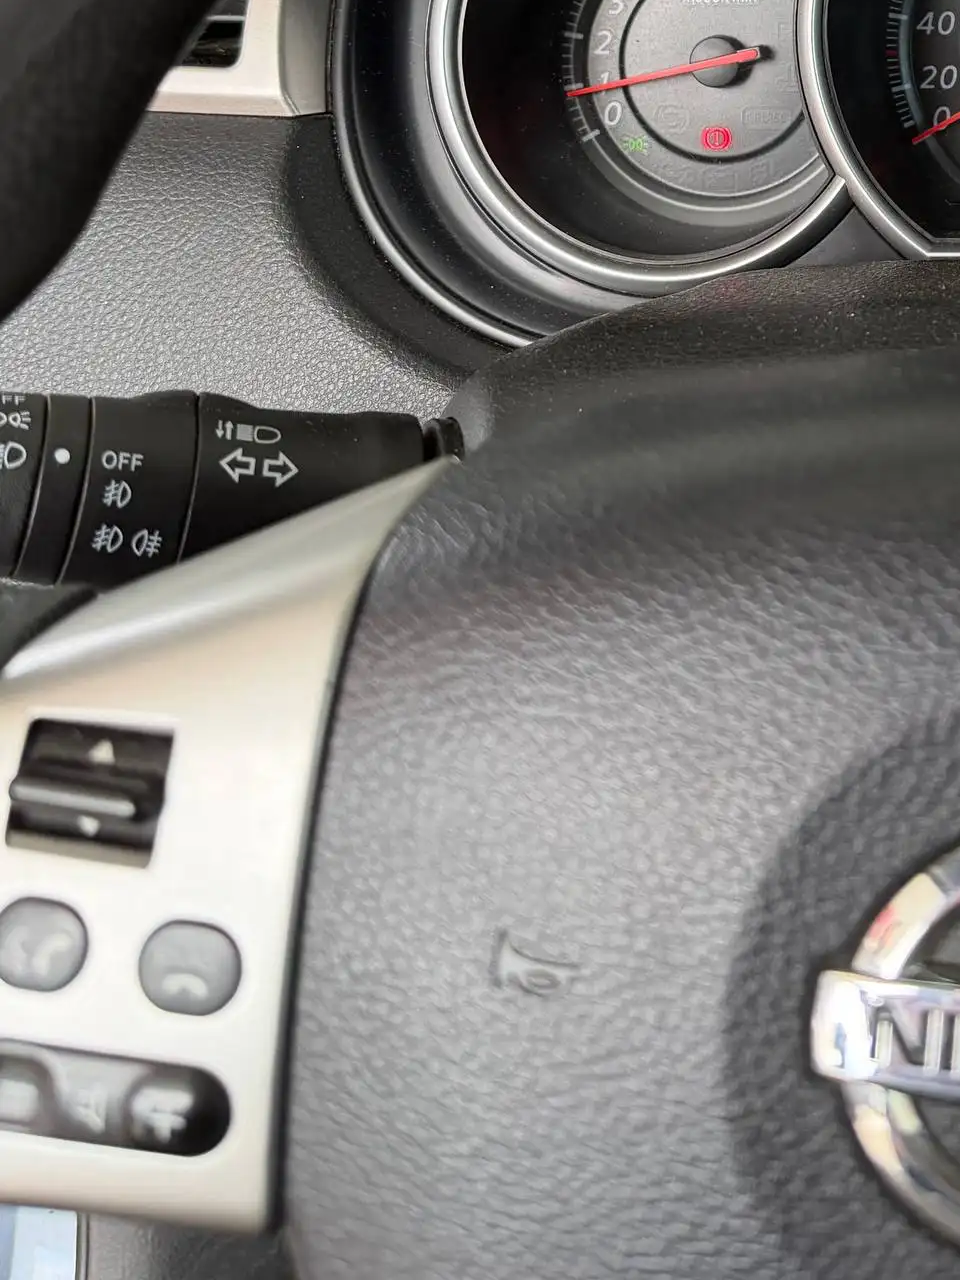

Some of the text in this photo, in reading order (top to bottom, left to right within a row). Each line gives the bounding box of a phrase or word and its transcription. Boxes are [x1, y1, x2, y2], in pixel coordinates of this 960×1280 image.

[916, 11, 956, 35] 40
[594, 30, 612, 55] 2
[919, 65, 958, 89] 20
[604, 102, 623, 126] 0
[0, 395, 26, 405] FF
[102, 450, 144, 472] OFF
